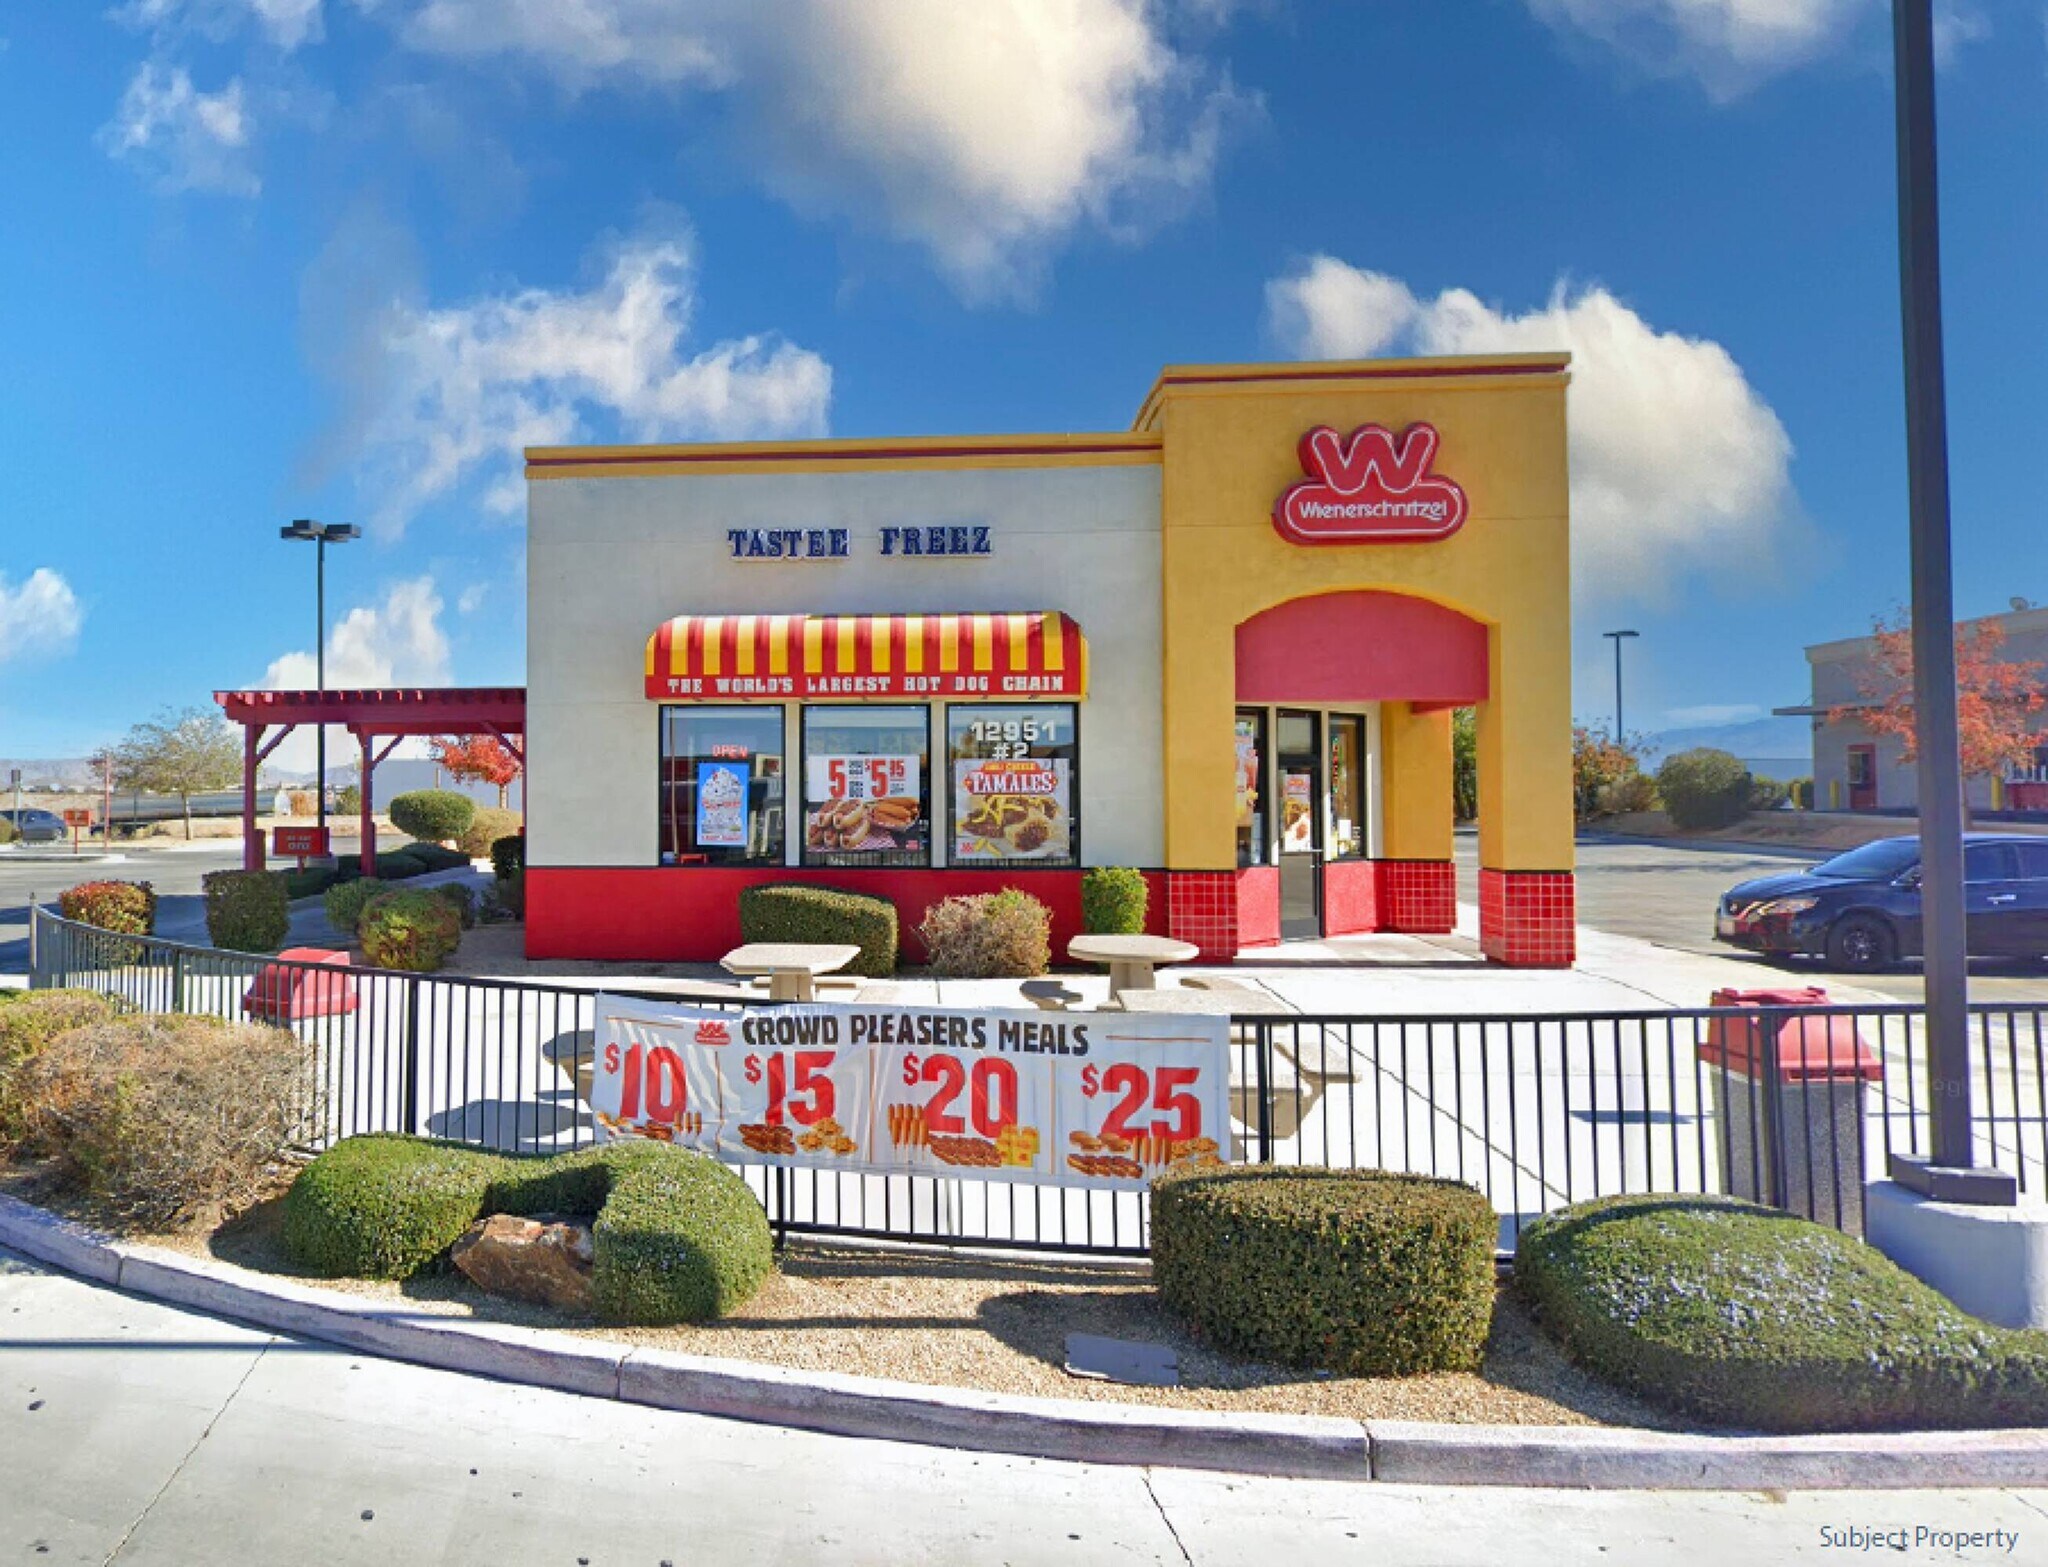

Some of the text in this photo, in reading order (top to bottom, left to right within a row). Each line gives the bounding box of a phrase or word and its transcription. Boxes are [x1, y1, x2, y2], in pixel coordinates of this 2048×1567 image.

[1299, 500, 1448, 521] Wienerschnitzel
[728, 526, 991, 557] TASTEE FREEZ
[667, 676, 1064, 693] THE WORLD'S LARGEST HOT DOG CHAIN
[971, 721, 1056, 741] 12951
[712, 745, 748, 758] OPEN
[992, 742, 1029, 759] #2
[828, 759, 846, 798] 5
[971, 772, 1053, 793] TAMALES
[742, 1014, 1088, 1056] CROWD PLEASERS MEALS
[605, 1042, 687, 1123] $10
[744, 1051, 836, 1125] $15
[903, 1051, 1018, 1139] $20
[1081, 1062, 1202, 1143] $25
